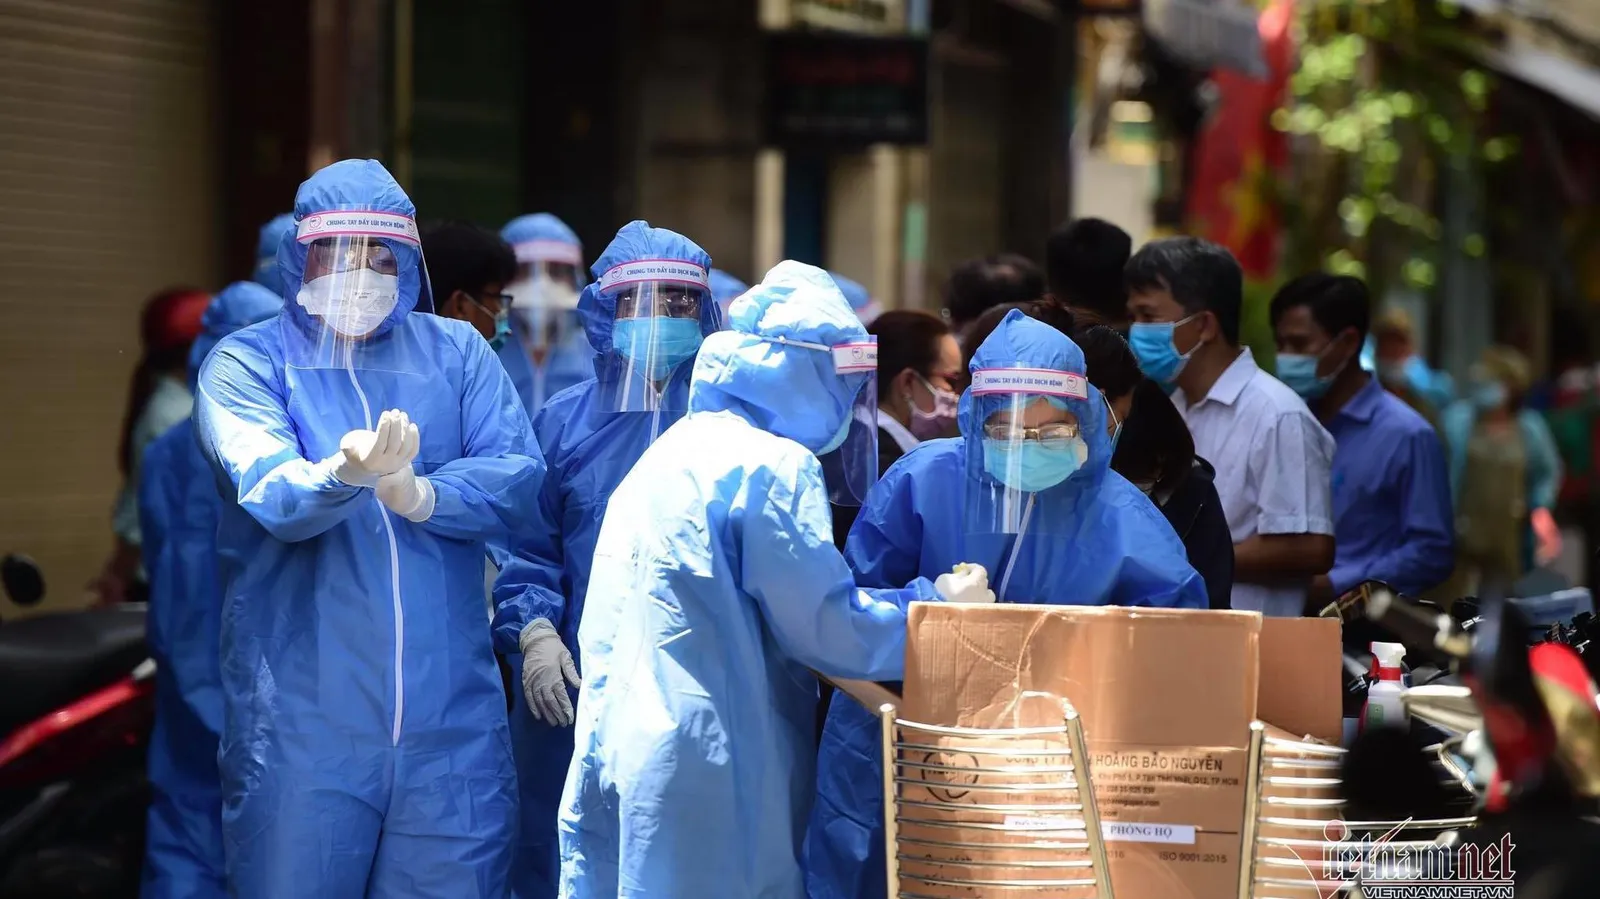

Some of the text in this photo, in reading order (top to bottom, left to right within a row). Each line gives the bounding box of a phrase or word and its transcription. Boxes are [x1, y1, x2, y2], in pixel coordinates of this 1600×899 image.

[1095, 751, 1138, 768] HOÀNG
[1142, 751, 1169, 769] BẢO
[1110, 823, 1173, 838] PHÒNG HỘ
[1159, 851, 1178, 861] ISO
